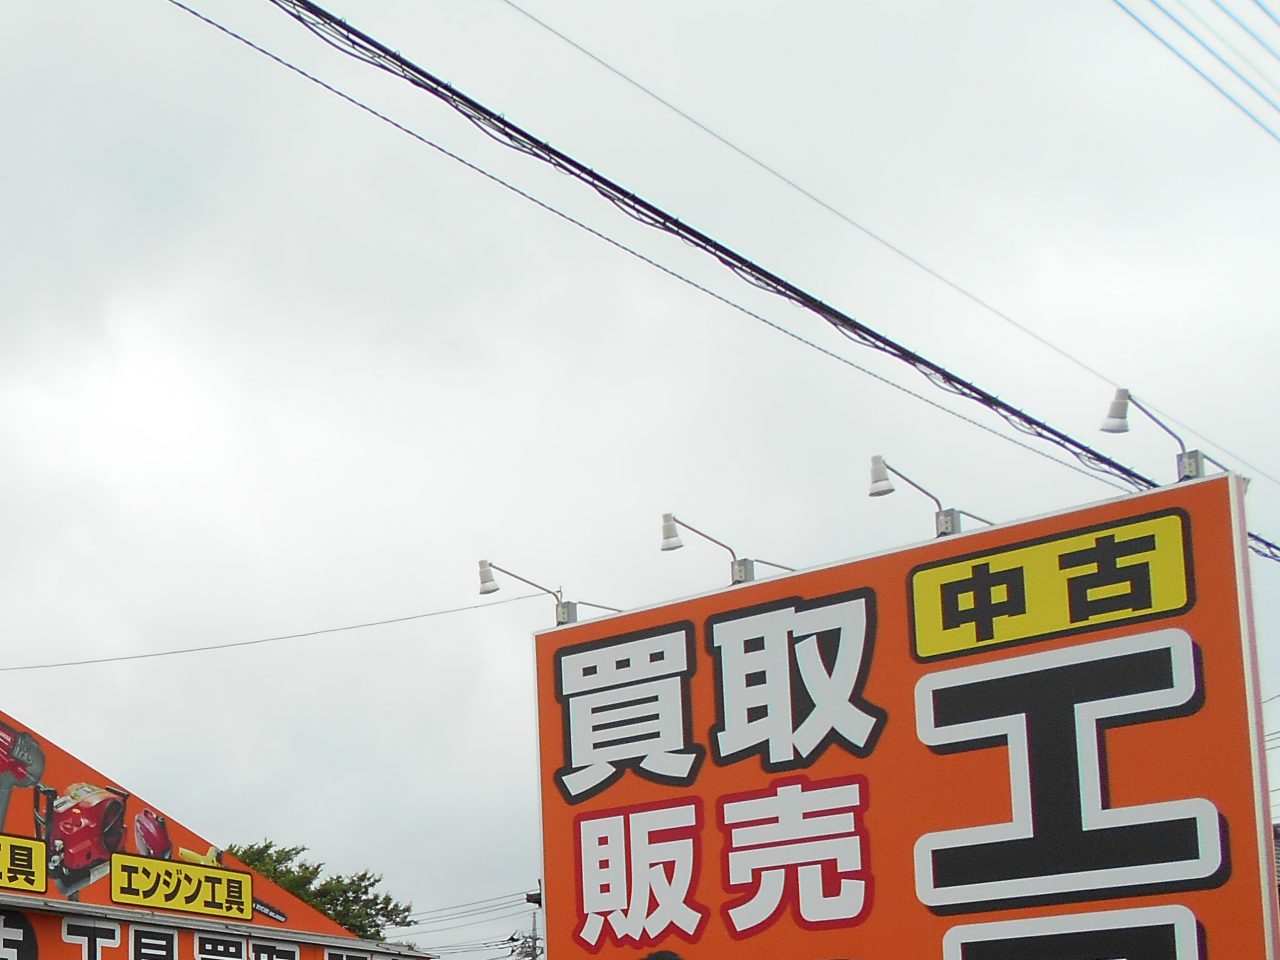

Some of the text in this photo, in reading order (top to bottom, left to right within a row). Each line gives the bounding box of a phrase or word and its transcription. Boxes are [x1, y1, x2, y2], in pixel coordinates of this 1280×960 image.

[941, 534, 1158, 643] 中古
[558, 598, 878, 796] 買取
[120, 865, 246, 915] エンジン工具
[579, 782, 866, 947] 販売
